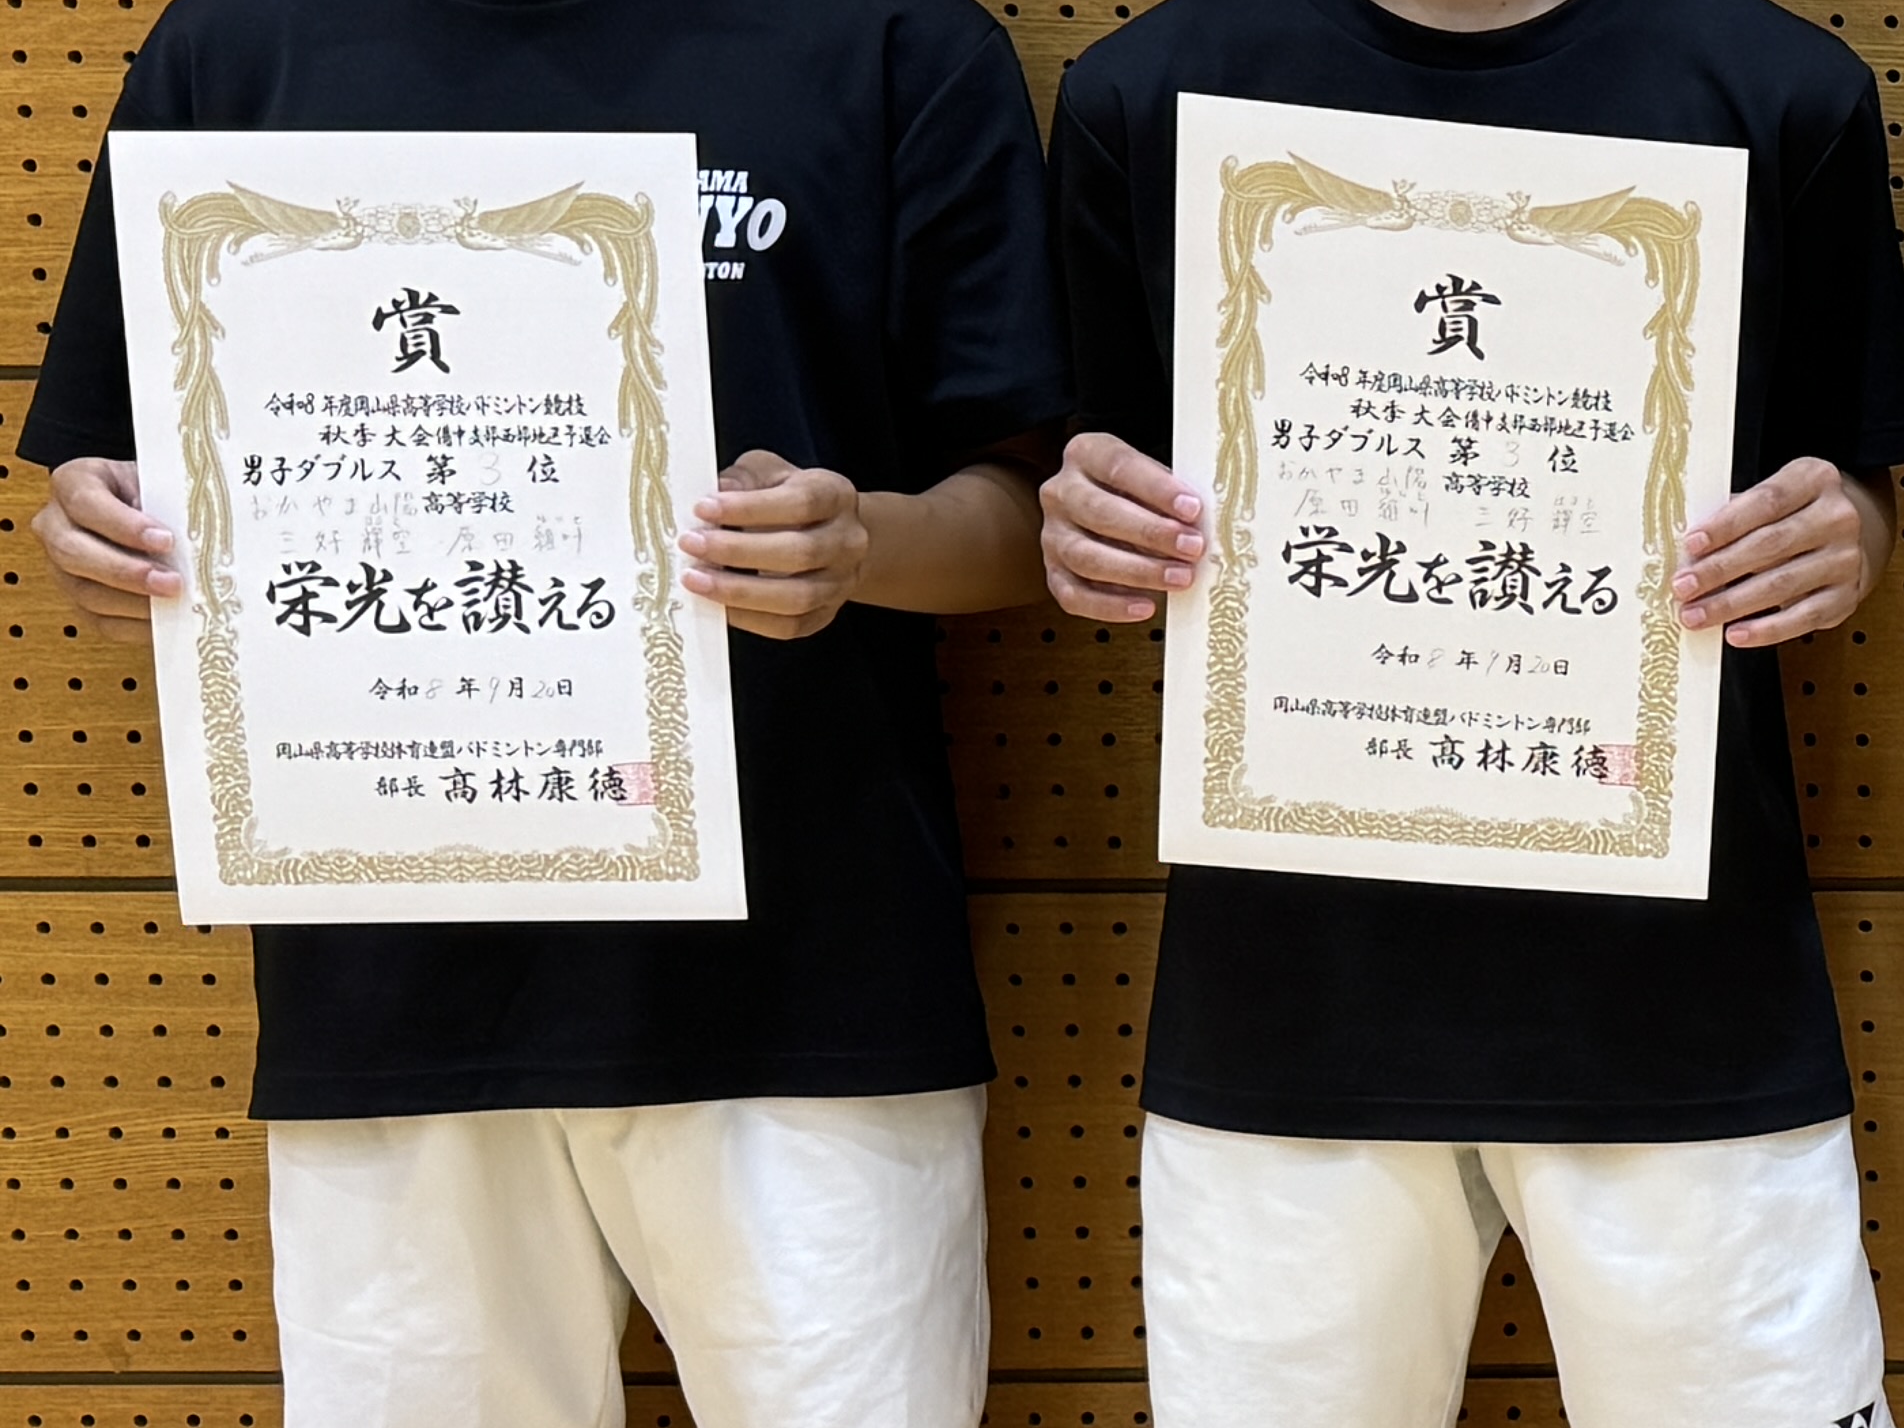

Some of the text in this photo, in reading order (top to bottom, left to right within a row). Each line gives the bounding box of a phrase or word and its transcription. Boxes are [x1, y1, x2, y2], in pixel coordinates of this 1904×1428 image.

[372, 287, 461, 373] 賞
[1412, 273, 1503, 360] 賞
[1271, 419, 1426, 459] 男子ダブルス
[241, 455, 401, 486] 男子ダブルス
[265, 561, 617, 635] 栄光を讃える
[1281, 524, 1618, 615] 栄光を讃える
[1365, 737, 1413, 761] 部長
[374, 775, 427, 800] 部長
